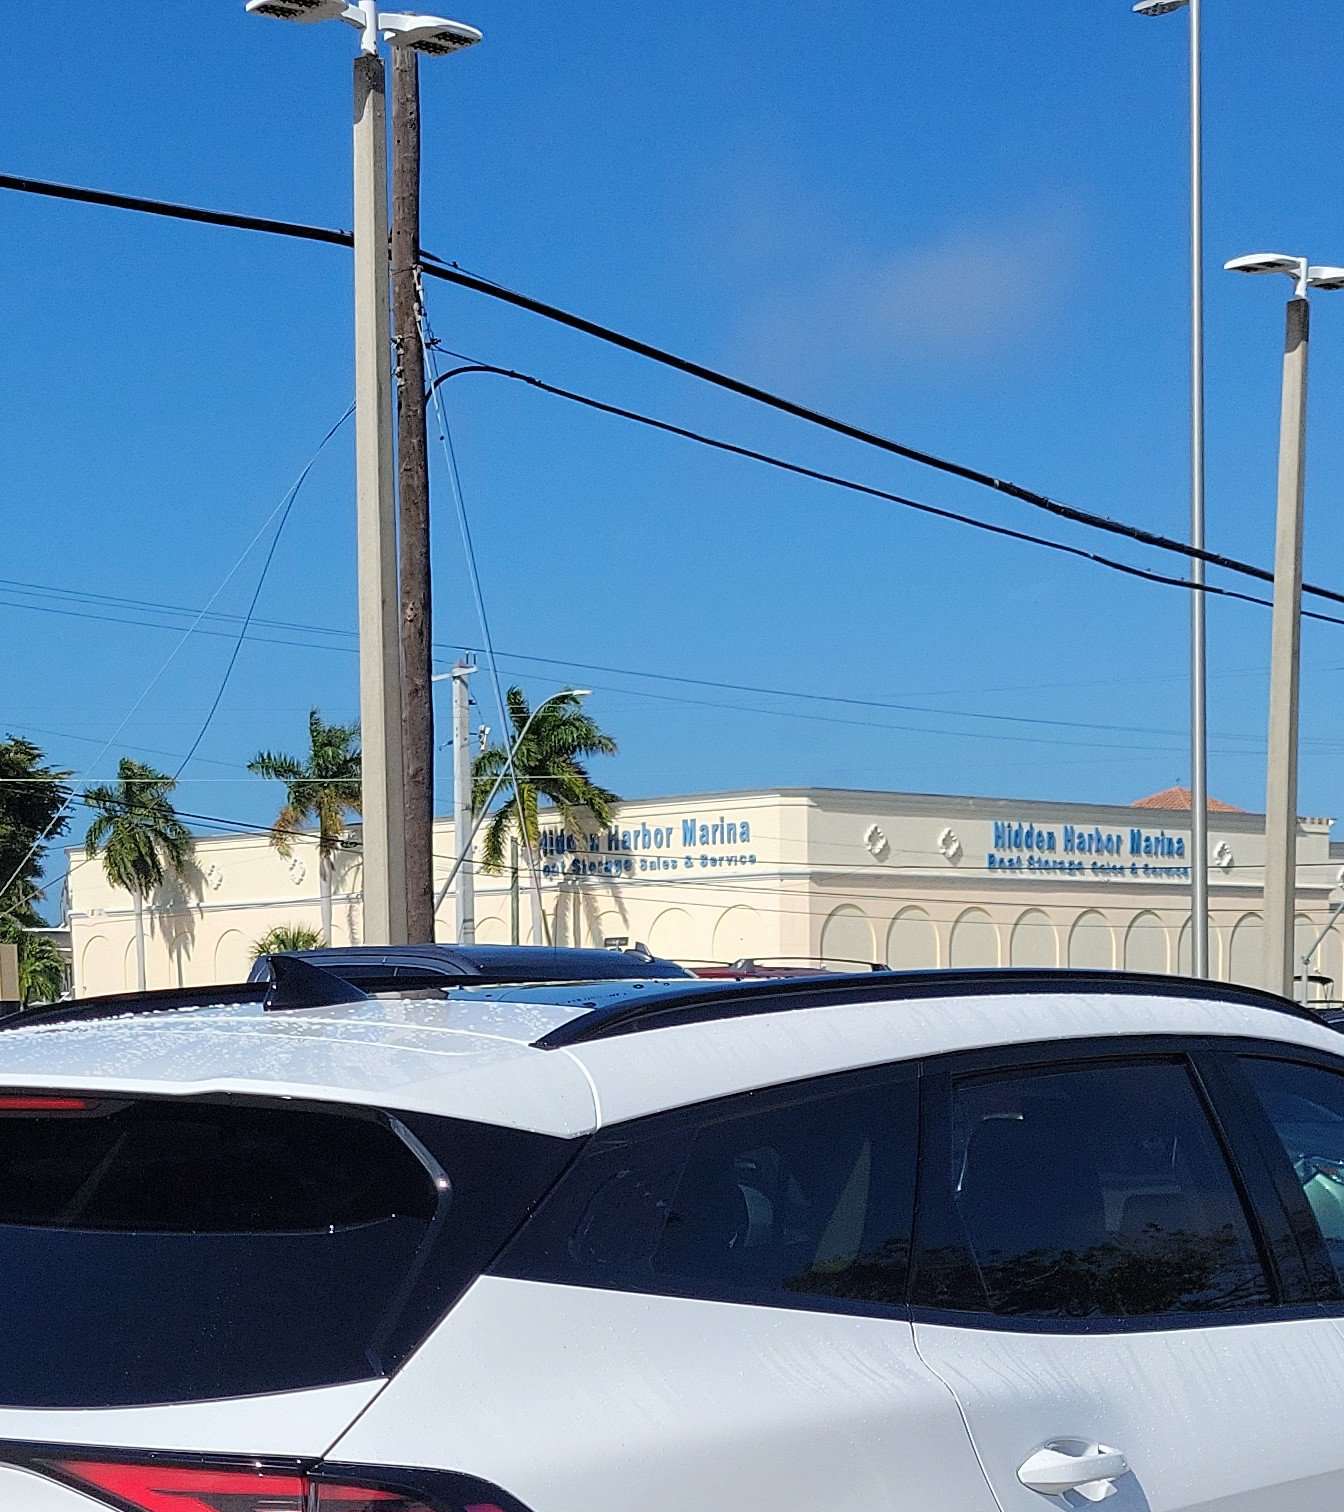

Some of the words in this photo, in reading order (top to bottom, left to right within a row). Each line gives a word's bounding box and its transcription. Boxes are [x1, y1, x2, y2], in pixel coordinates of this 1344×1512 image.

[608, 822, 673, 851] Harbor
[682, 816, 751, 847] Marina
[994, 821, 1056, 850] Hidden
[1064, 825, 1123, 853] Harbor
[1130, 828, 1185, 856] Marina
[572, 858, 632, 878] Storage
[640, 855, 678, 871] Sales
[684, 855, 694, 868] &
[700, 853, 757, 867] Service
